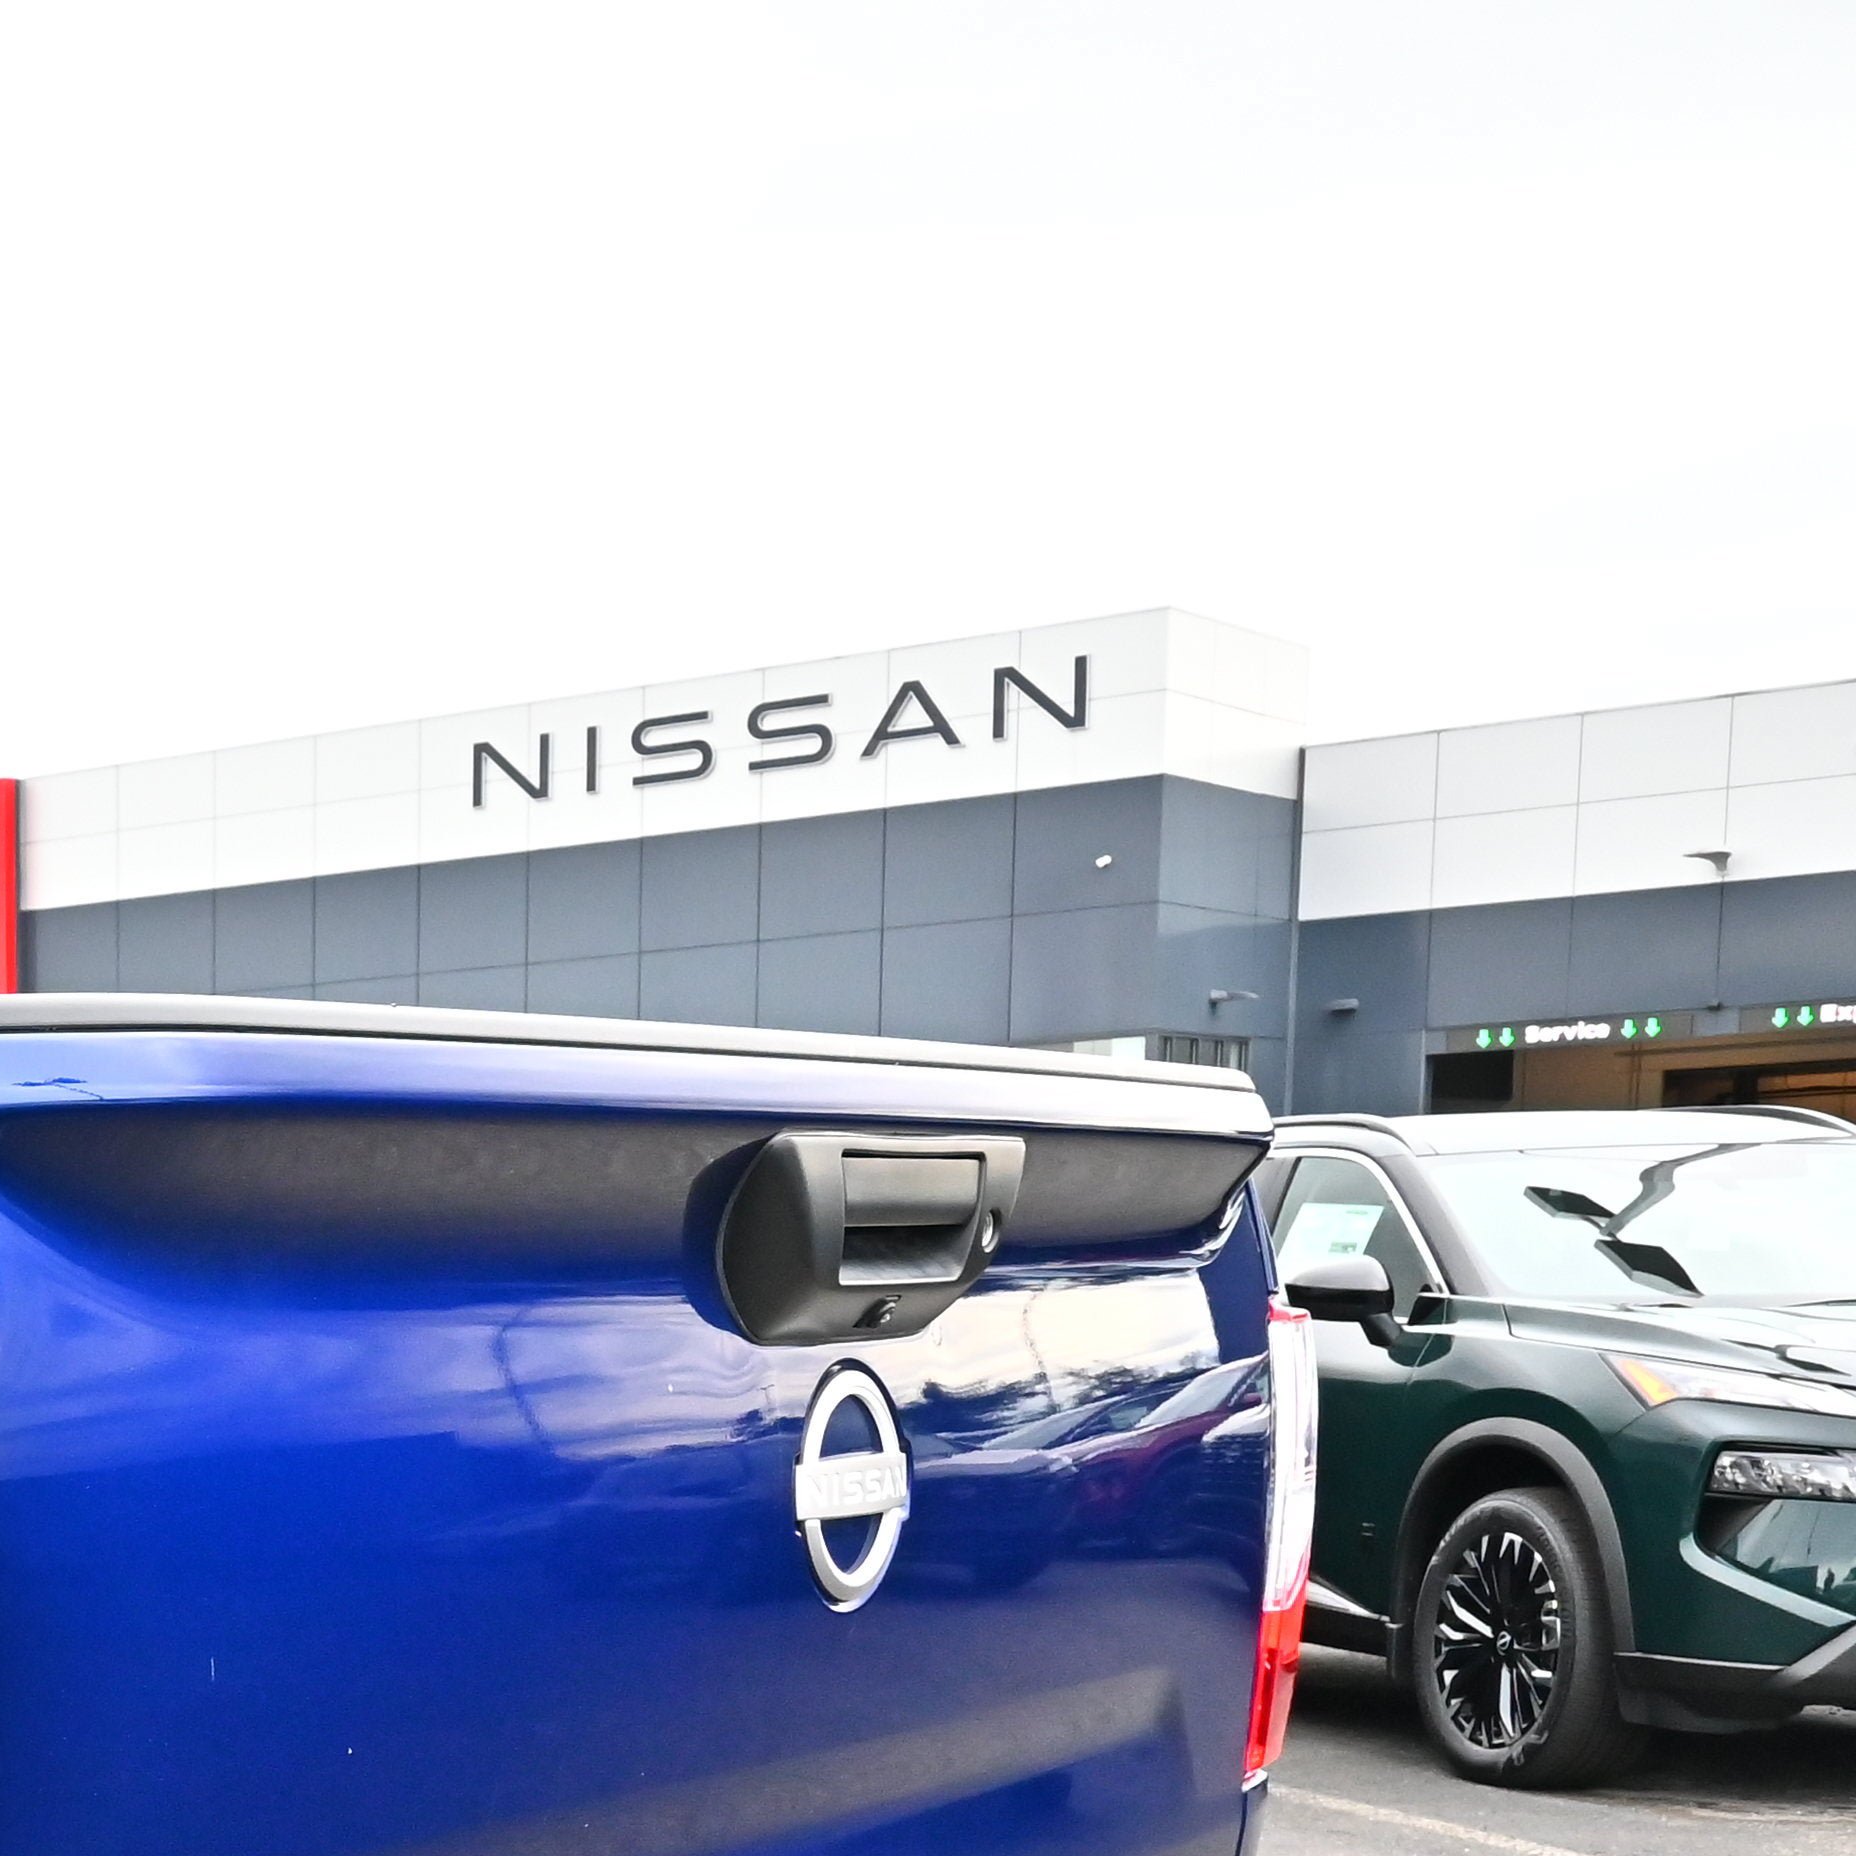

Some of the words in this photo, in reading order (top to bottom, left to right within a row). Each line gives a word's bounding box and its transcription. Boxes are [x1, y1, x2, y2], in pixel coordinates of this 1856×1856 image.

[472, 655, 1089, 808] NISSAN
[1524, 1020, 1611, 1044] Service
[807, 1463, 908, 1508] NISSAN
